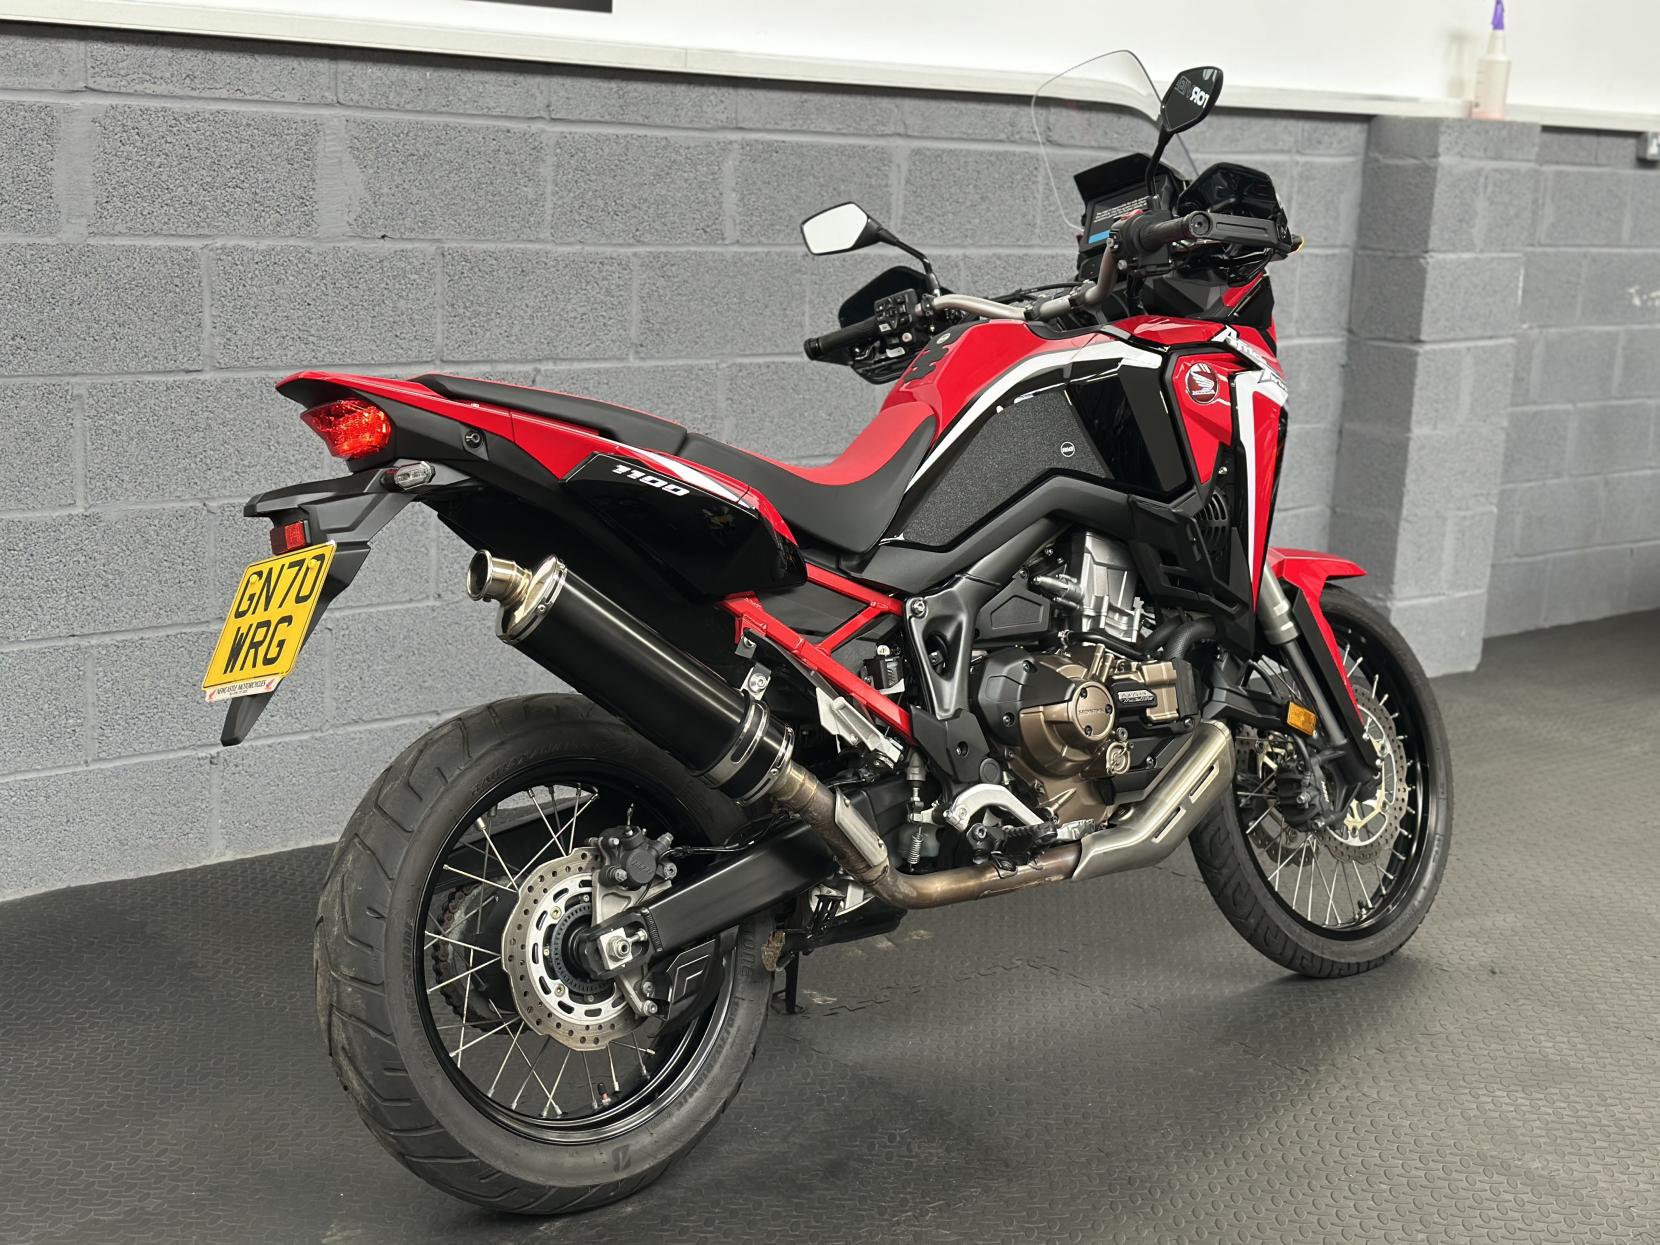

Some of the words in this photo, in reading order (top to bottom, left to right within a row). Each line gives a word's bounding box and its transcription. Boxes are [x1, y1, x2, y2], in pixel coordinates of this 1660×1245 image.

[612, 464, 690, 497] 1100
[234, 553, 326, 620] GN70
[223, 615, 293, 675] WRG
